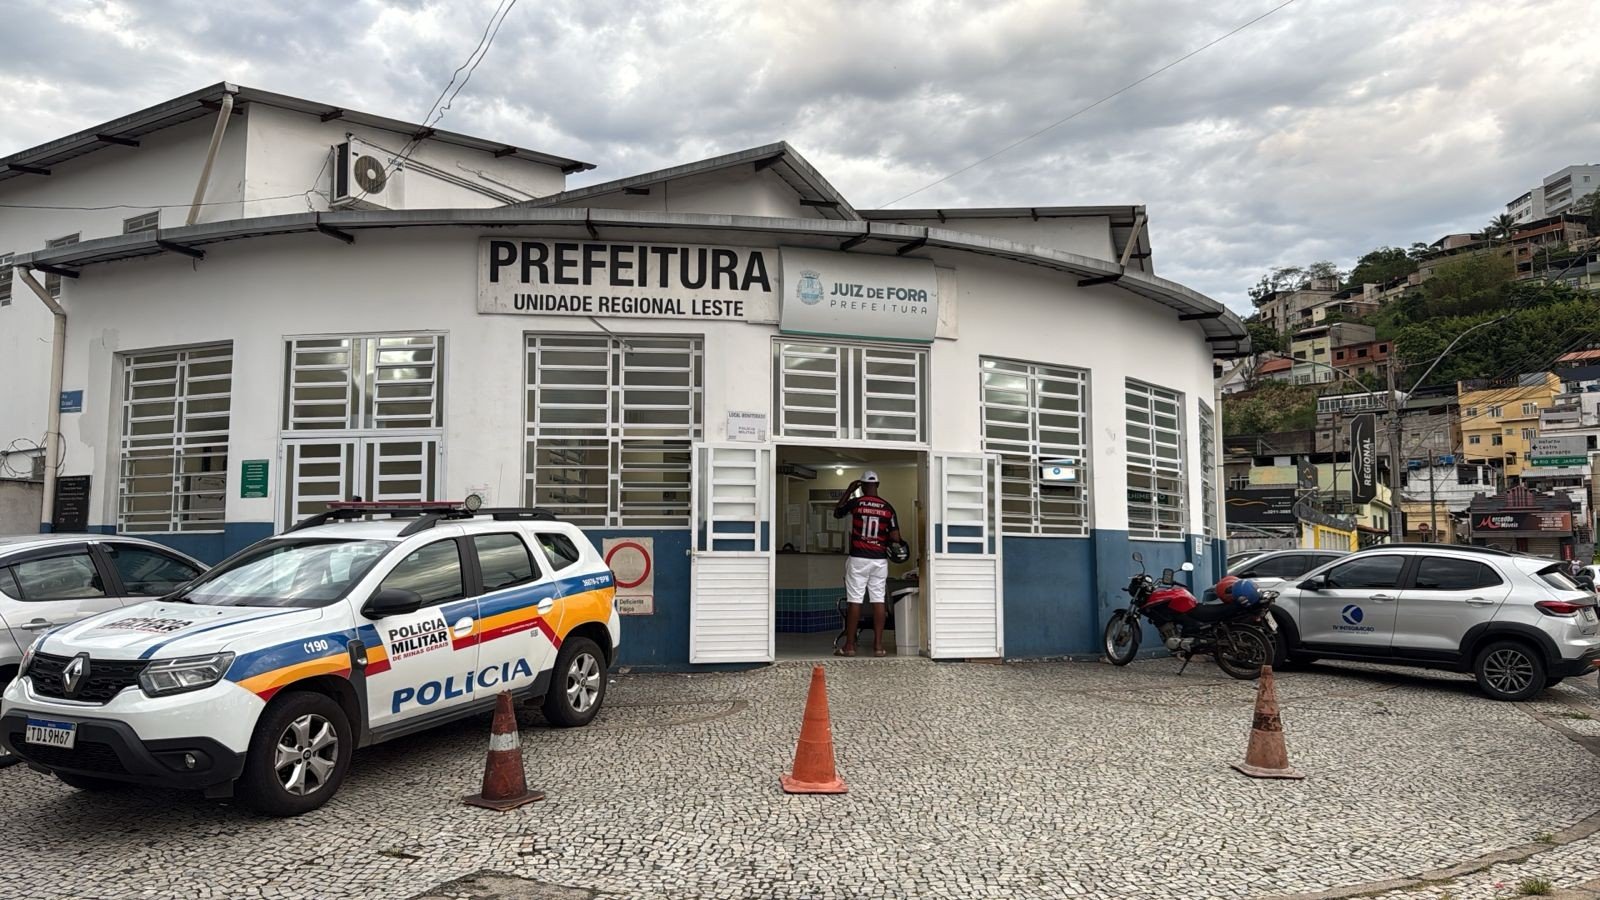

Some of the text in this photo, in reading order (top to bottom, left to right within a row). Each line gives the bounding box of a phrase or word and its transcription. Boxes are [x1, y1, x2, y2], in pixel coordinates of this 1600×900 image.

[489, 240, 772, 293] PREFEITURA
[830, 282, 928, 303] JUIZ DE FORA
[513, 293, 744, 317] UNIDADE REGIONAL LESTE
[830, 299, 928, 315] PREFEITURA
[1362, 437, 1372, 487] REGIONAL
[861, 515, 880, 539] 10
[391, 630, 448, 656] MILITAR
[392, 641, 449, 662] DE MINAS GERAIS
[31, 726, 71, 746] TDI9H67
